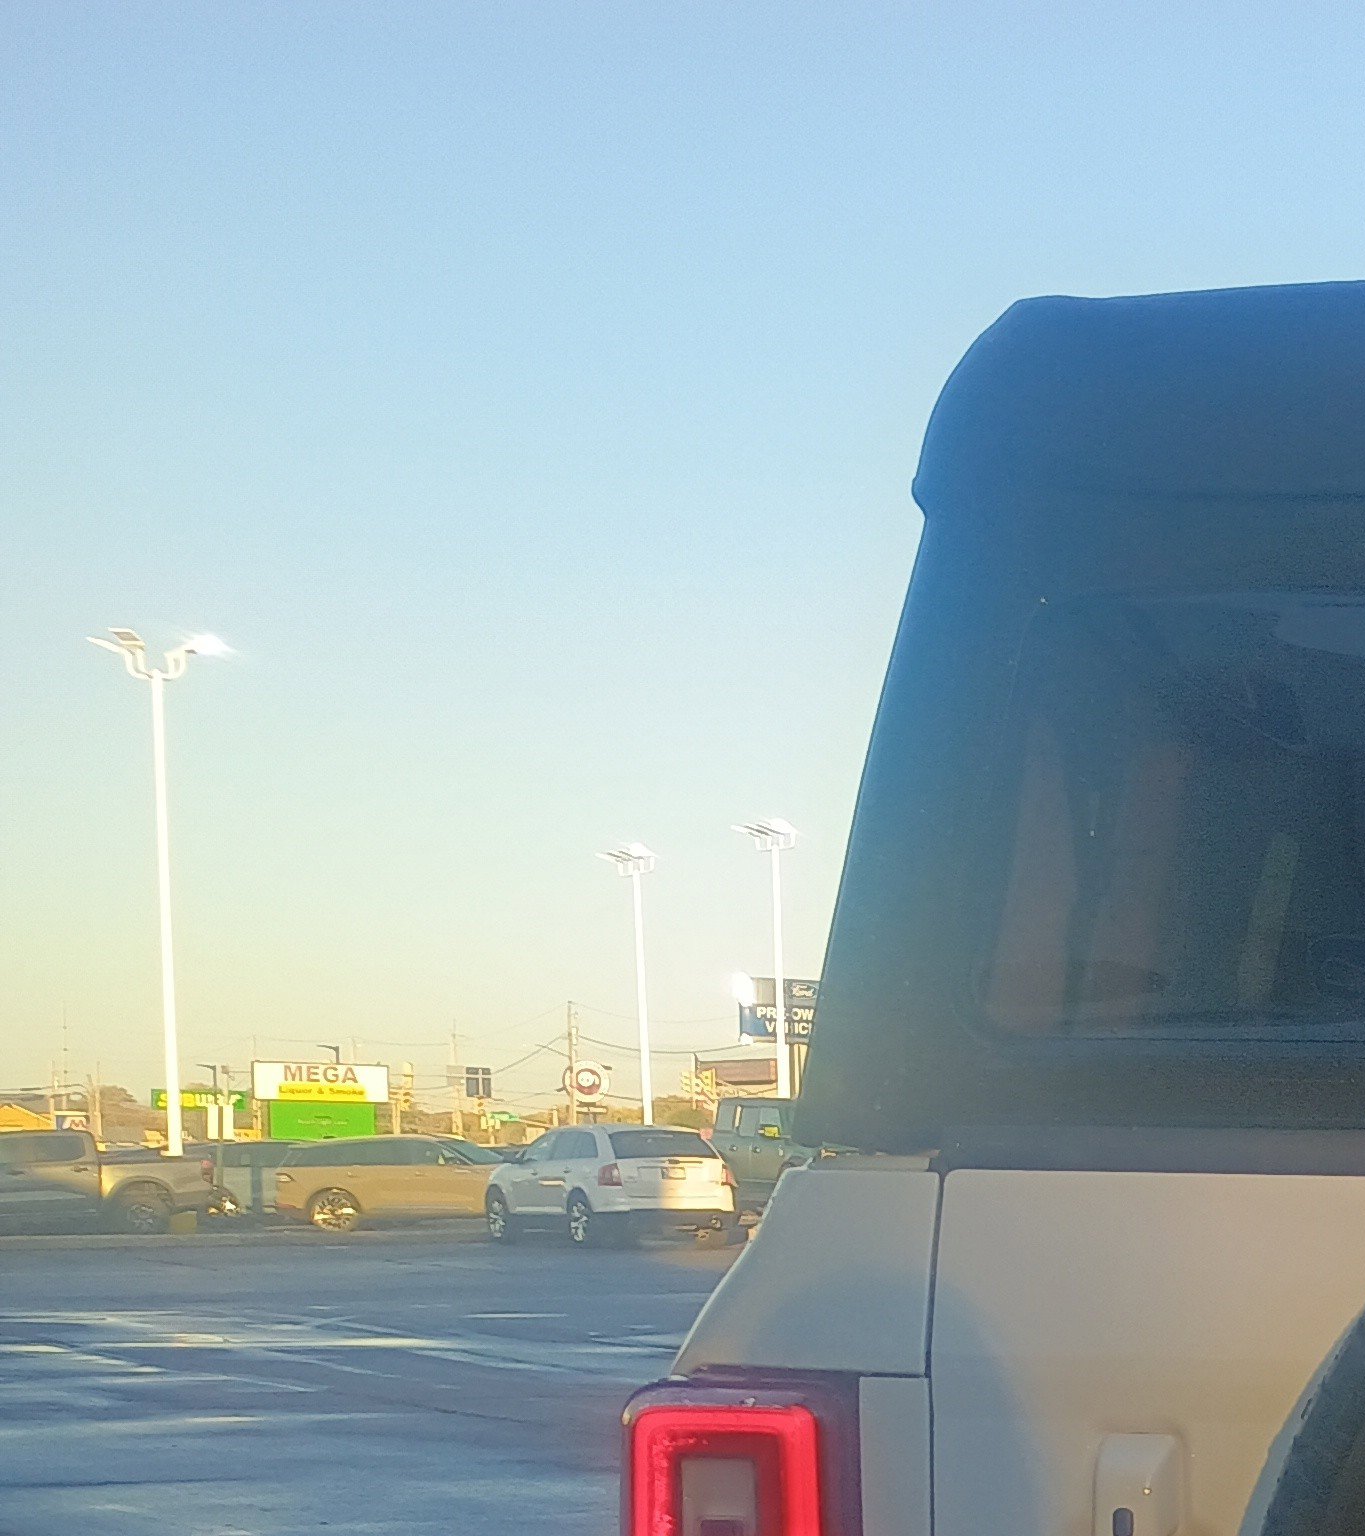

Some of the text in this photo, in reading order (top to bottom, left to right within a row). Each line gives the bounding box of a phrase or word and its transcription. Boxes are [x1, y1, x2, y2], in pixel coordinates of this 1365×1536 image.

[283, 1065, 358, 1083] MEGA
[279, 1086, 312, 1095] Liquor
[329, 1088, 365, 1096] Smoke
